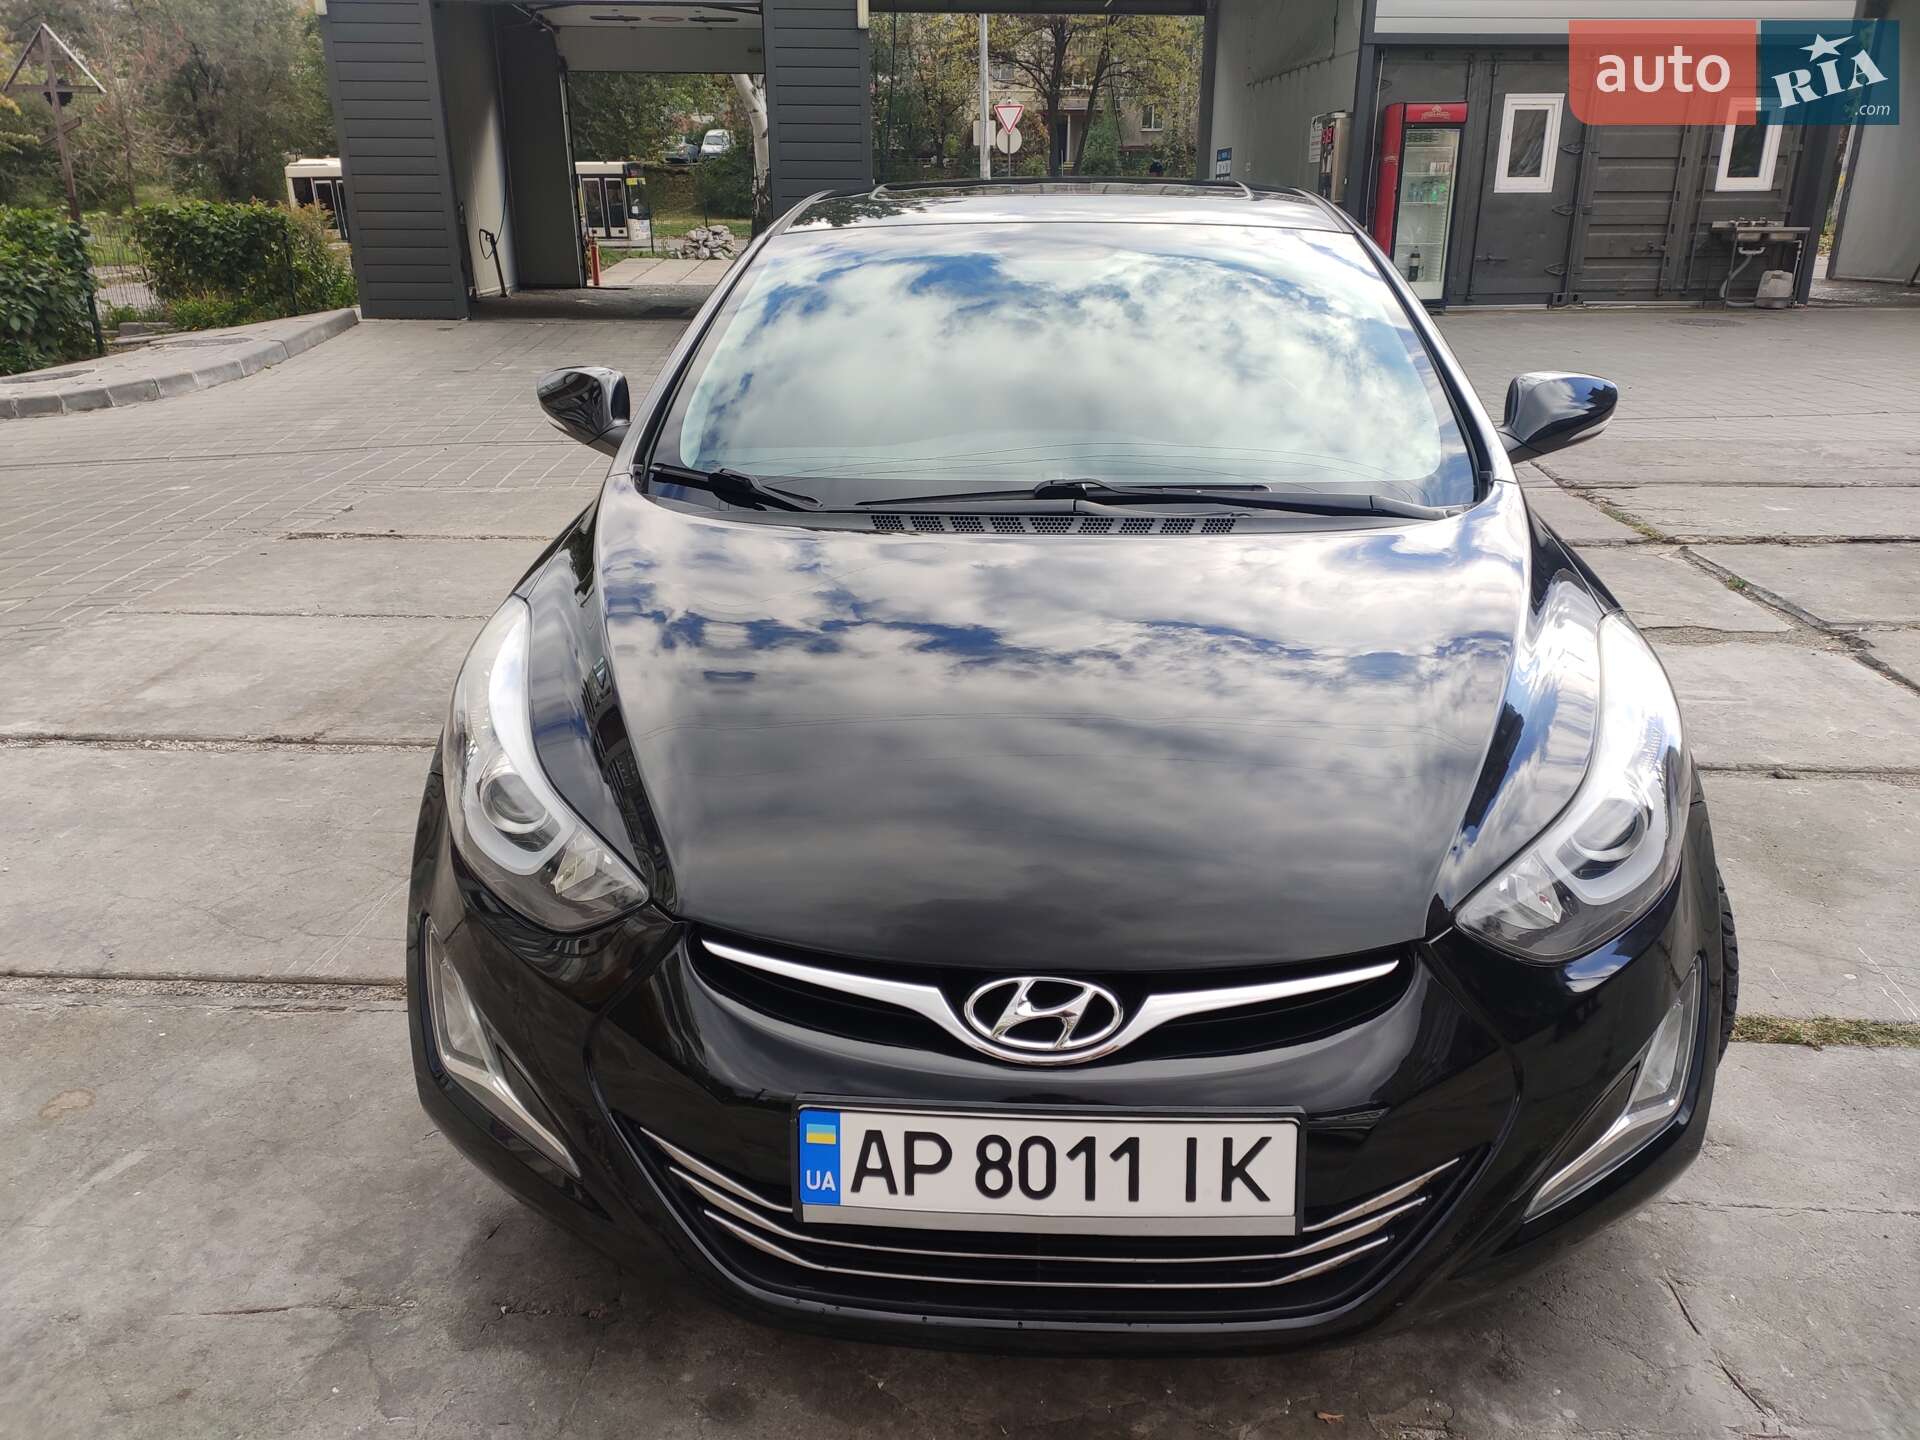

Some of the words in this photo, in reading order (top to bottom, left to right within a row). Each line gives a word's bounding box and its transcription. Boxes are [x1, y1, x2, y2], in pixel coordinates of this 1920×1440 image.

[806, 1170, 837, 1191] UA
[850, 1129, 953, 1196] AP
[975, 1134, 1140, 1202] 8011
[1185, 1136, 1273, 1202] IK
